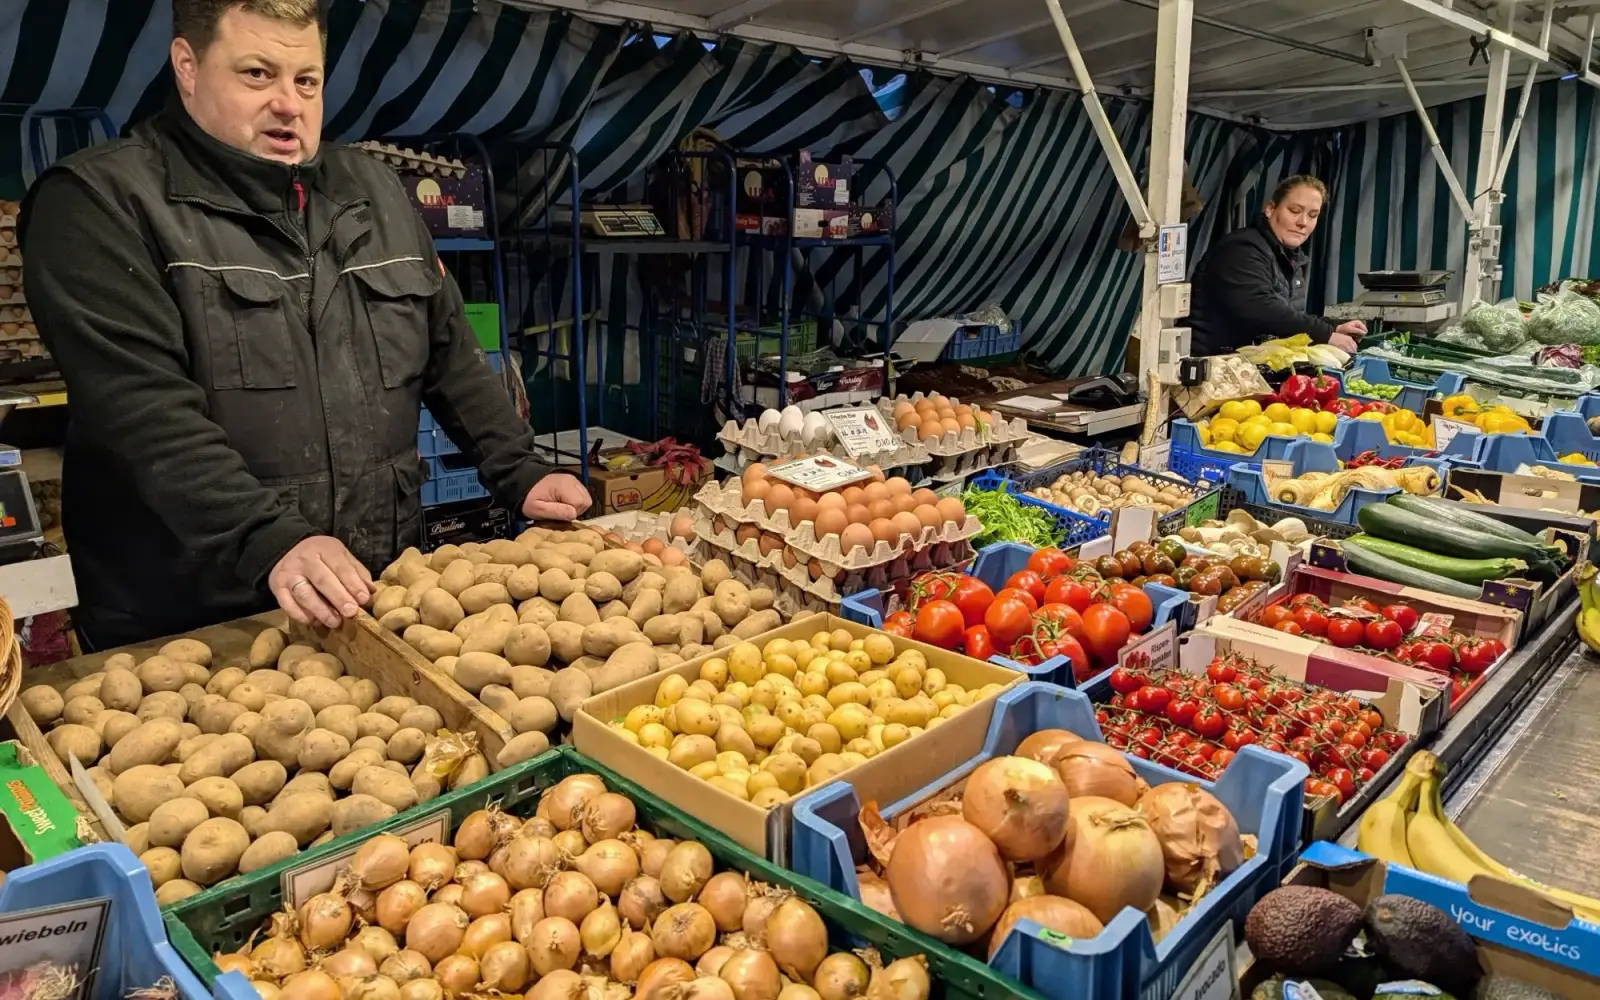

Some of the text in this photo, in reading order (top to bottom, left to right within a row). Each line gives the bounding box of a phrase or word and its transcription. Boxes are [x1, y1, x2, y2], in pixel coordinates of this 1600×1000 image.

[617, 491, 639, 504] Dole
[430, 520, 466, 536] Pauline
[1451, 903, 1581, 960] your exotics
